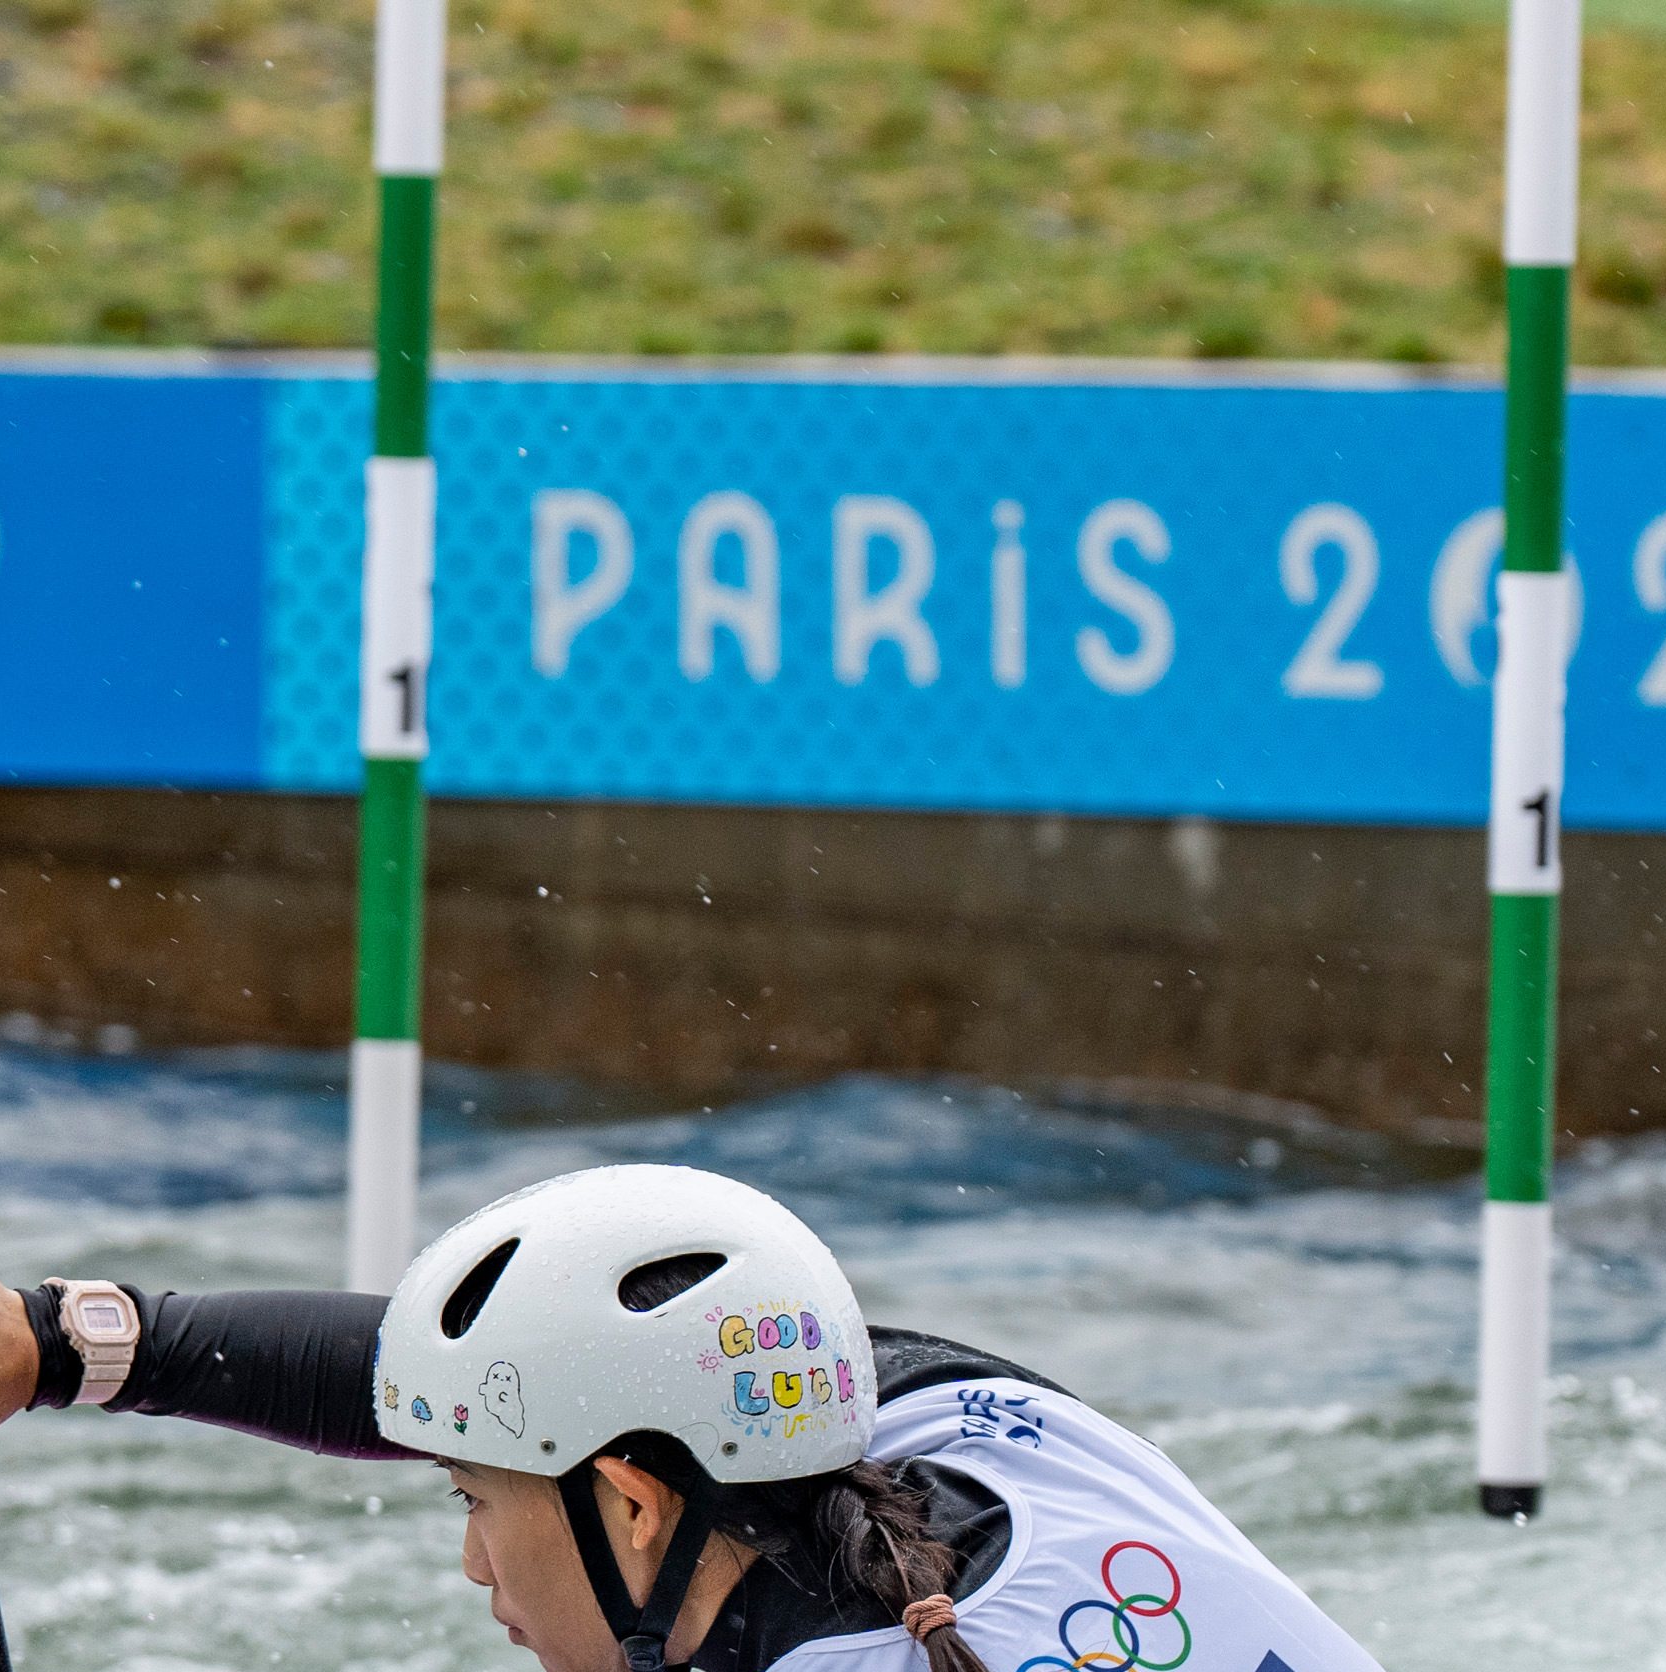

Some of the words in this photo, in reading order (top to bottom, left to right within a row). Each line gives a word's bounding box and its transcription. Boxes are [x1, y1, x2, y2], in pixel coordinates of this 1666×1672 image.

[388, 660, 415, 736] 1
[1521, 787, 1549, 868] 1
[719, 1311, 821, 1358] GOOD
[734, 1359, 855, 1415] LUCK
